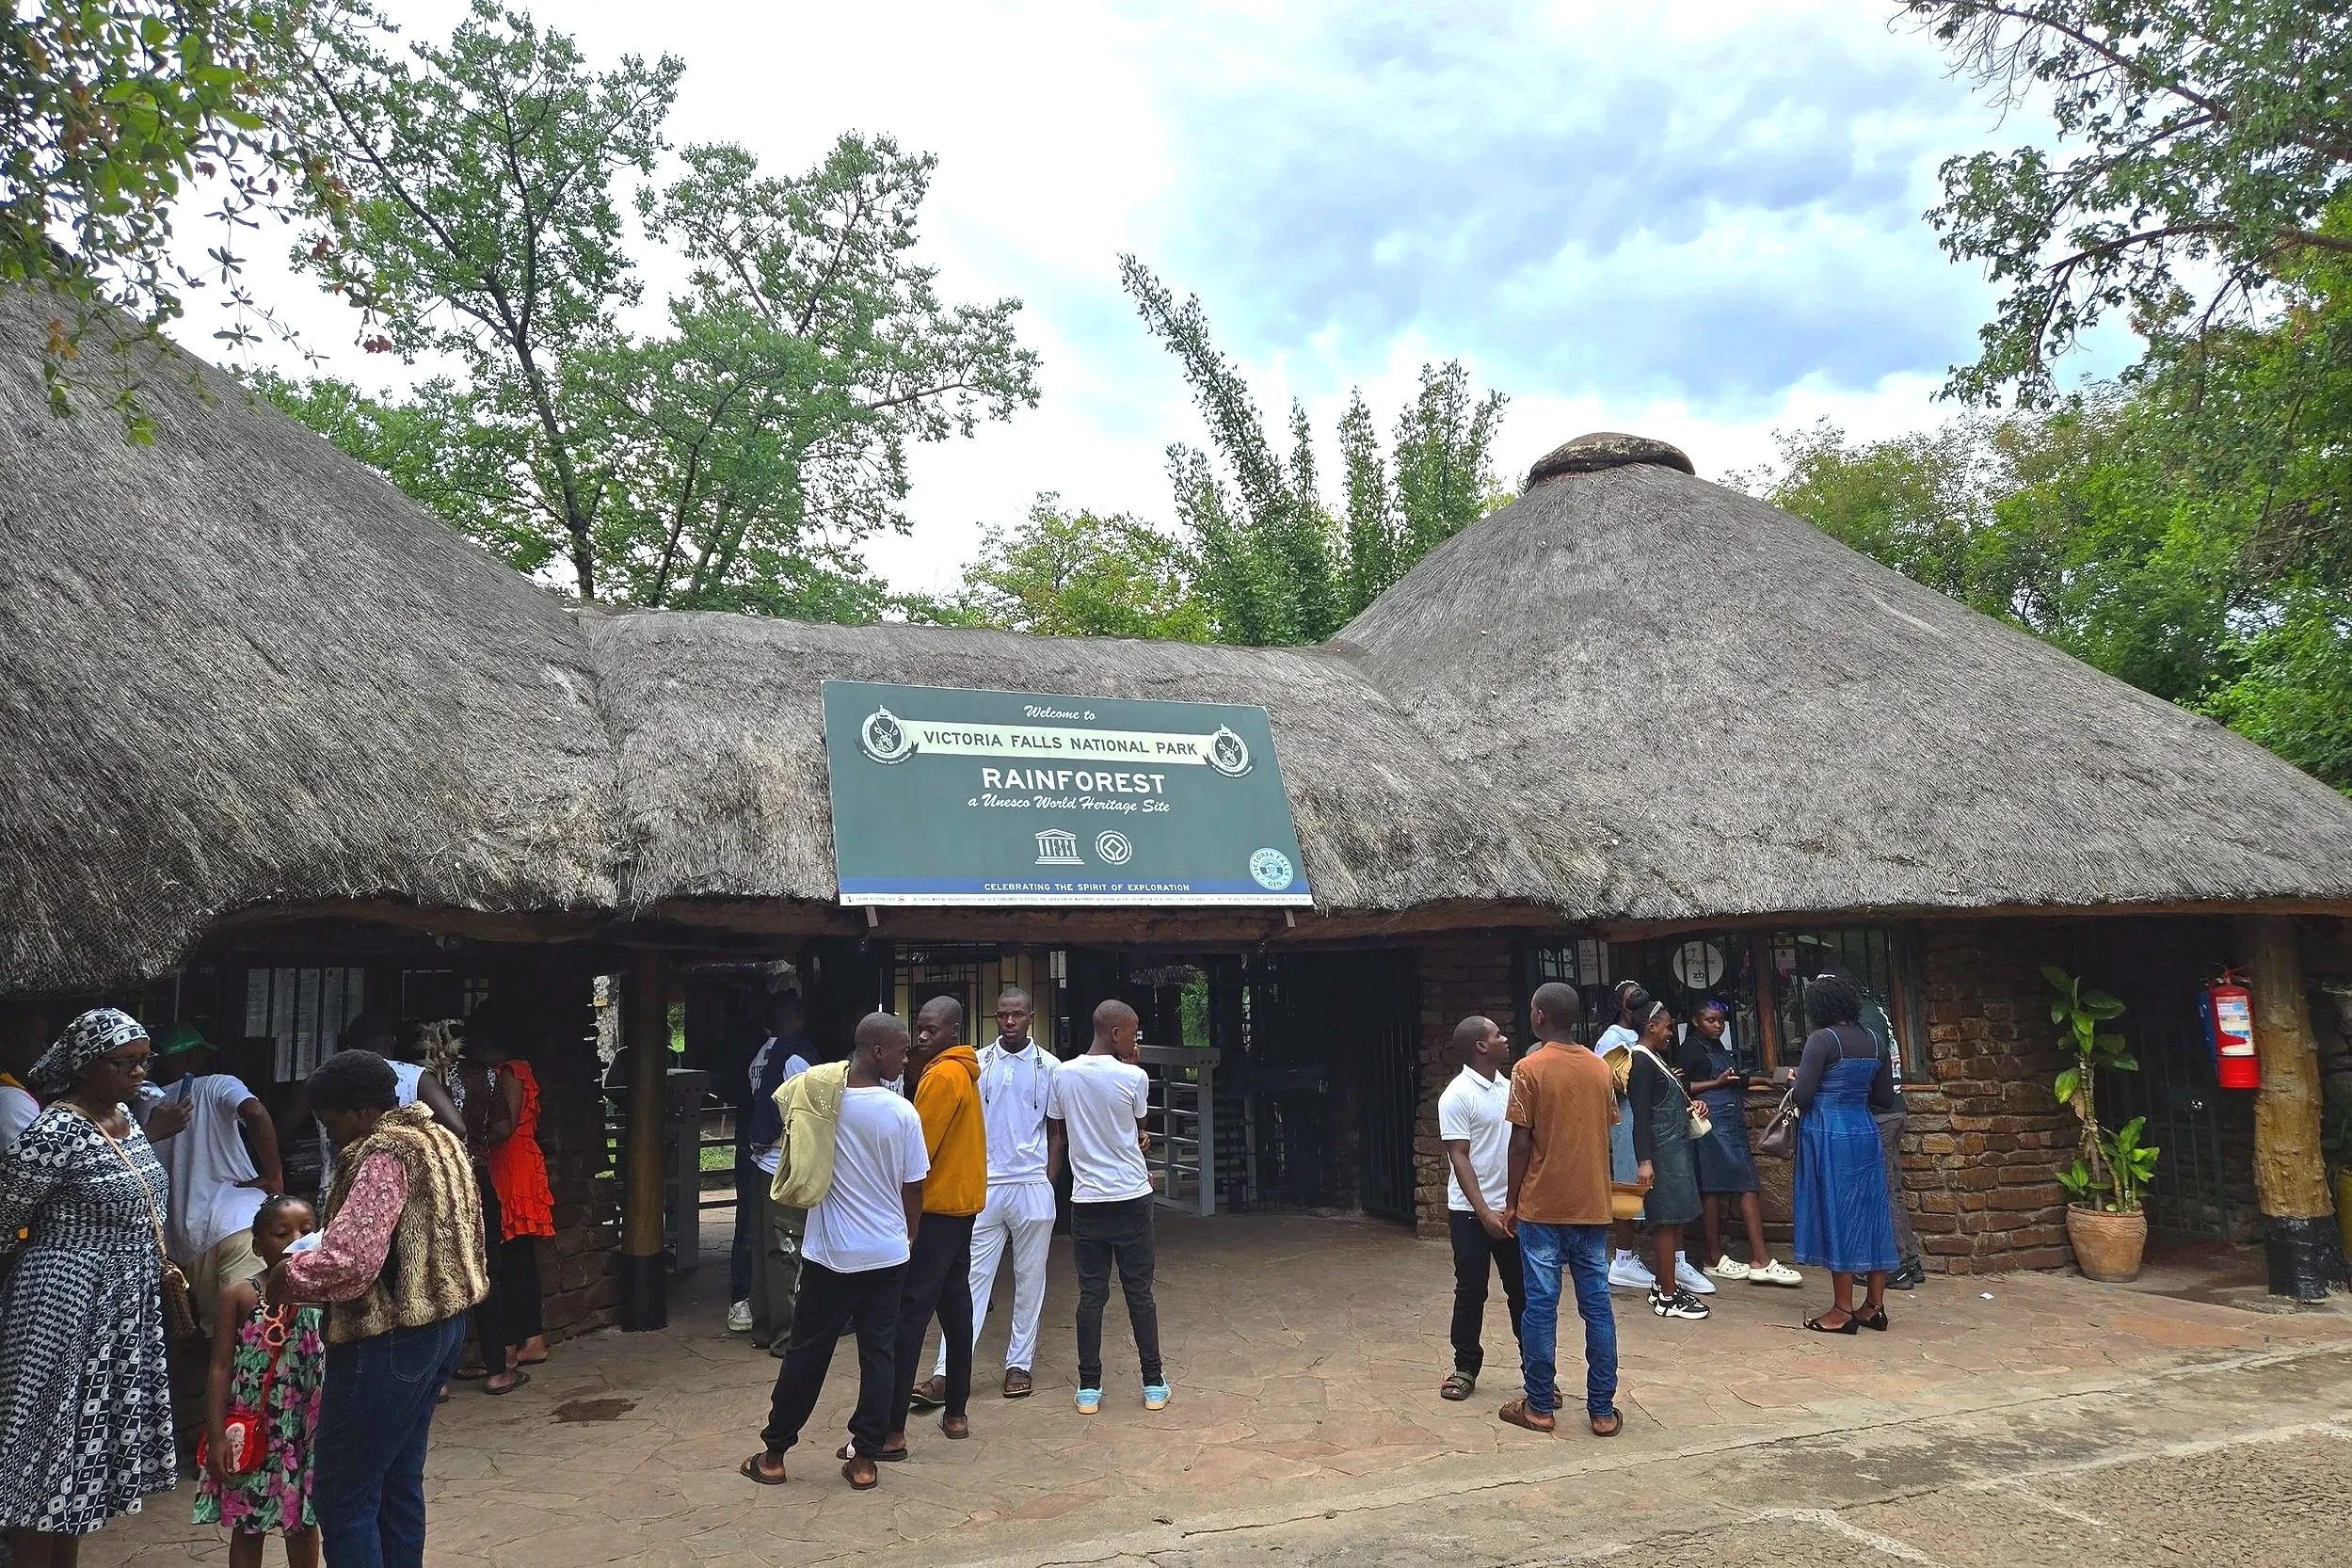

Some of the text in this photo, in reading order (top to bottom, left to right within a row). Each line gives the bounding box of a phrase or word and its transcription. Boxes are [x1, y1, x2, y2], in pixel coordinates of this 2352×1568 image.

[1023, 704, 1096, 721] Welcome to
[922, 730, 1198, 756] VICTORIA FALLS NATIONAL PARK
[981, 767, 1166, 794] RAINFOREST
[968, 793, 1172, 815] a Unesco World Heritage Site
[1252, 851, 1291, 878] VICTORIA FALLS
[984, 882, 1191, 892] CELEBRATING THE SPIRIT OF EXPLORATION
[1268, 880, 1283, 888] GIN
